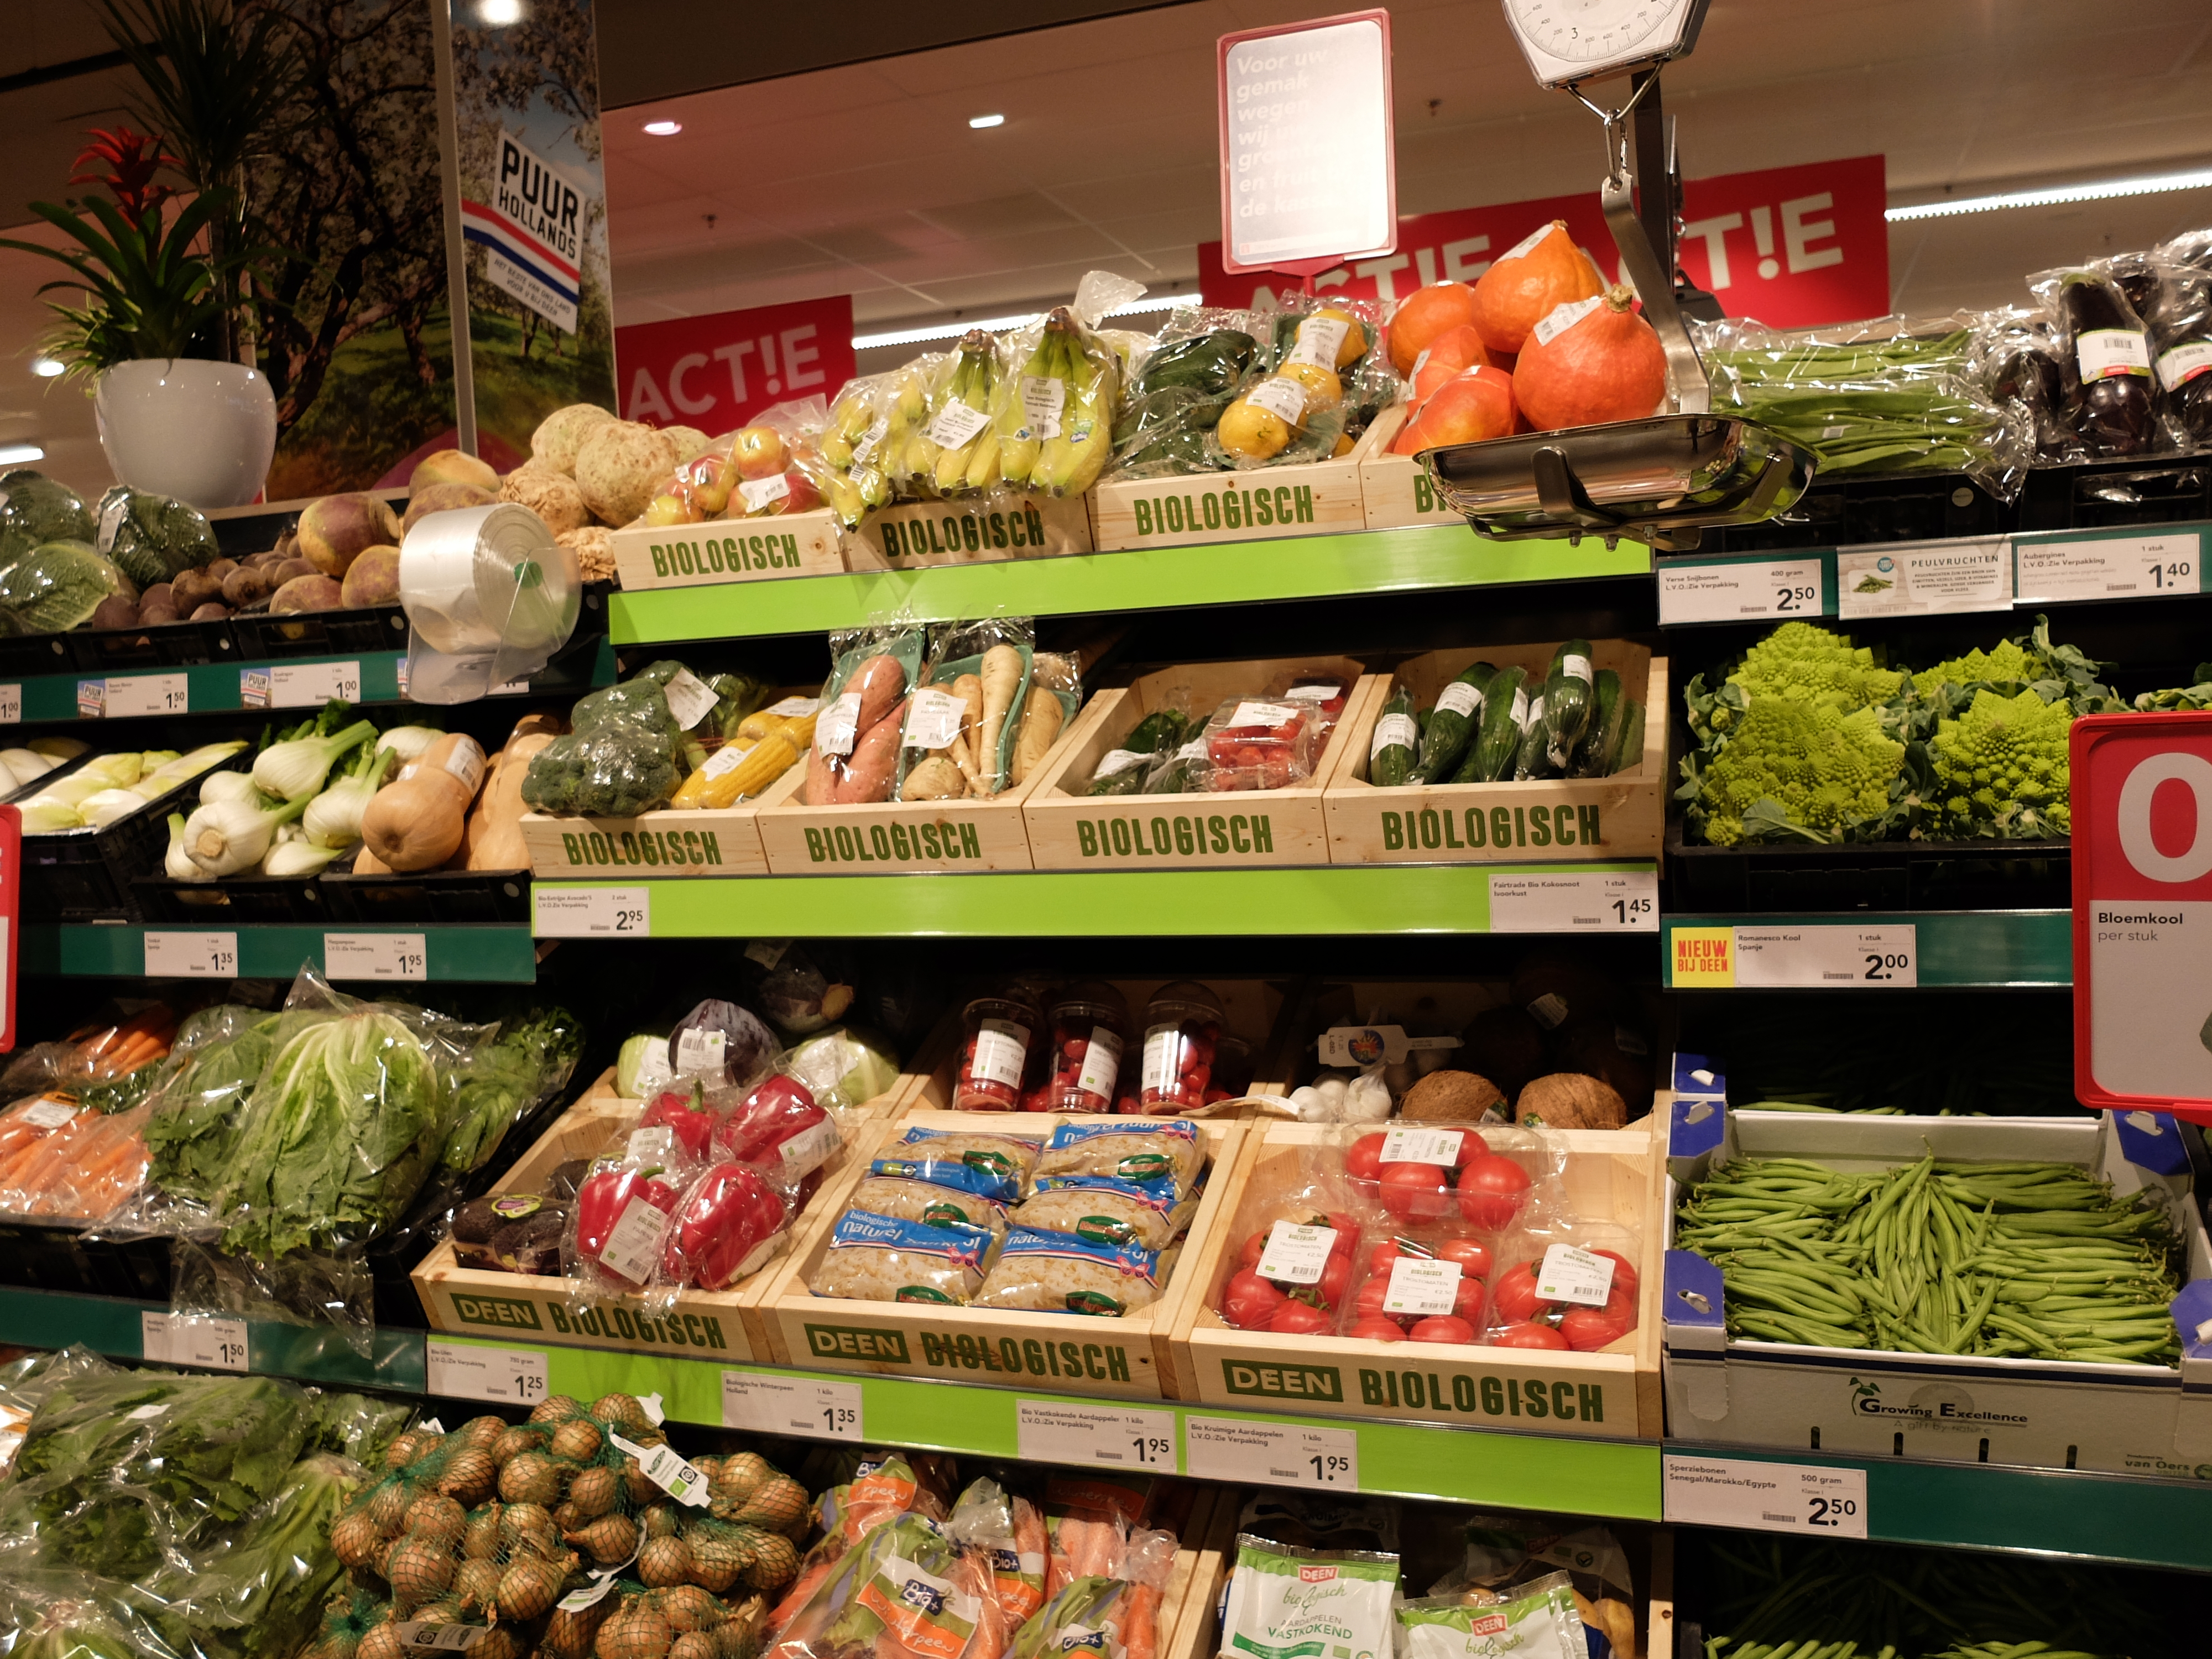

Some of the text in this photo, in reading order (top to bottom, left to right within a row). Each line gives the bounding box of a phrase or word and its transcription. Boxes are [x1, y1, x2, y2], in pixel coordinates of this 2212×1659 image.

[1571, 28, 1578, 39] 3
[1237, 49, 1328, 75] Voor uw
[1237, 70, 1311, 103] gemak
[1237, 100, 1311, 123] wegen
[1238, 123, 1269, 148] wij
[501, 139, 578, 236] PUUR
[1239, 176, 1265, 192] en
[1272, 166, 1318, 188] fruit
[1239, 197, 1267, 217] de
[499, 186, 576, 259] HOLLANDS
[1134, 484, 1314, 536] BIOLOGISCH
[880, 510, 1046, 559] BIOLOGISCH
[650, 534, 801, 578] BIOLOGISCH
[1911, 555, 1999, 568] PEULVRUCHTEN
[2023, 551, 2066, 560] Aubergines
[2063, 557, 2106, 566] Verpakking
[1701, 581, 1739, 589] Verpakking
[249, 673, 267, 686] PUUR
[1076, 815, 1274, 858] BIOLOGISCH
[1381, 804, 1601, 851] BIOLOGISCH
[562, 831, 723, 866] BIOLOGISCH
[804, 823, 982, 863] BIOLOGISCH
[2098, 912, 2184, 925] Bloemkool
[2098, 929, 2159, 943] per stuk
[1678, 940, 1728, 958] NIEUW
[1738, 943, 1764, 952] Spanje
[1678, 959, 1728, 972] BIJ DEEN
[849, 1210, 899, 1227] biologische
[843, 1221, 903, 1240] naturel
[460, 1298, 727, 1349] DEEN BIOLOGISCH
[817, 1330, 1131, 1383] DEEN BIOLOGISCH
[726, 1378, 794, 1392] Biologische Winterpeen
[1232, 1365, 1605, 1423] DEEN BIOLOGISCH
[1034, 1409, 1077, 1420] Vastkokende
[1859, 1398, 2028, 1423] Growing Excellence
[1056, 1420, 1094, 1431] Verpakking
[1204, 1425, 1237, 1434] Kruimige
[1238, 1427, 1284, 1438] Aardappelen
[1228, 1436, 1269, 1447] Verpakking
[1670, 1463, 1726, 1475] Sperziebonen
[2125, 1459, 2190, 1472] van Oers
[1669, 1473, 1777, 1489] Senegal/Marokko/Egypte
[1801, 1474, 1817, 1483] 500
[1302, 1568, 1335, 1581] DEEN
[1283, 1583, 1348, 1616] biologisch
[1281, 1615, 1342, 1627] AARDAPPELEN
[1474, 1616, 1504, 1634] DEEN
[1268, 1623, 1353, 1640] VASTKOKEND
[1465, 1632, 1525, 1657] biologisch
